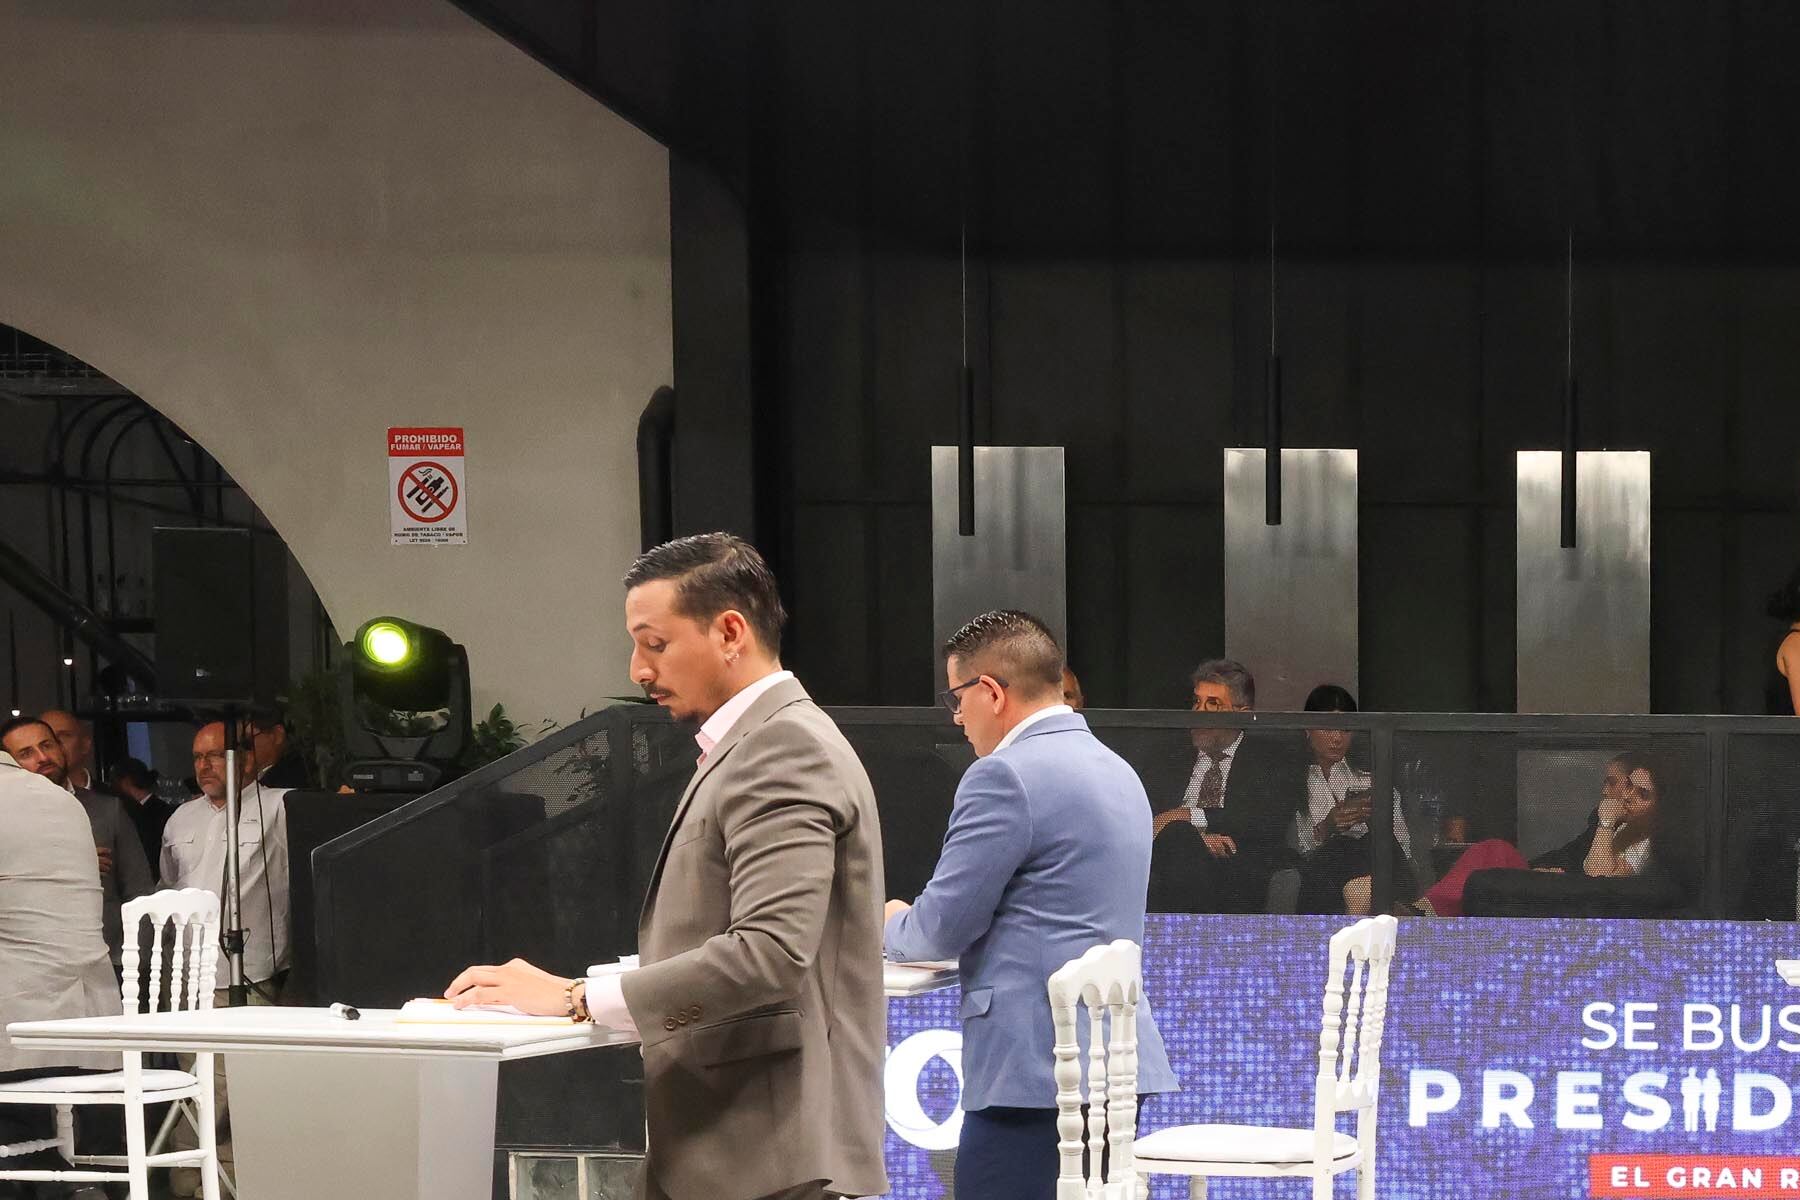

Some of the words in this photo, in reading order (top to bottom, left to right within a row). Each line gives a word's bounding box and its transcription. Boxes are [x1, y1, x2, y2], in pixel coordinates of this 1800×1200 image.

[390, 443, 420, 451] FUMAR
[394, 434, 457, 444] PROHIBIDO
[1581, 1001, 1659, 1050] SE
[1611, 1166, 1649, 1188] EL
[1666, 1167, 1763, 1189] GRAN
